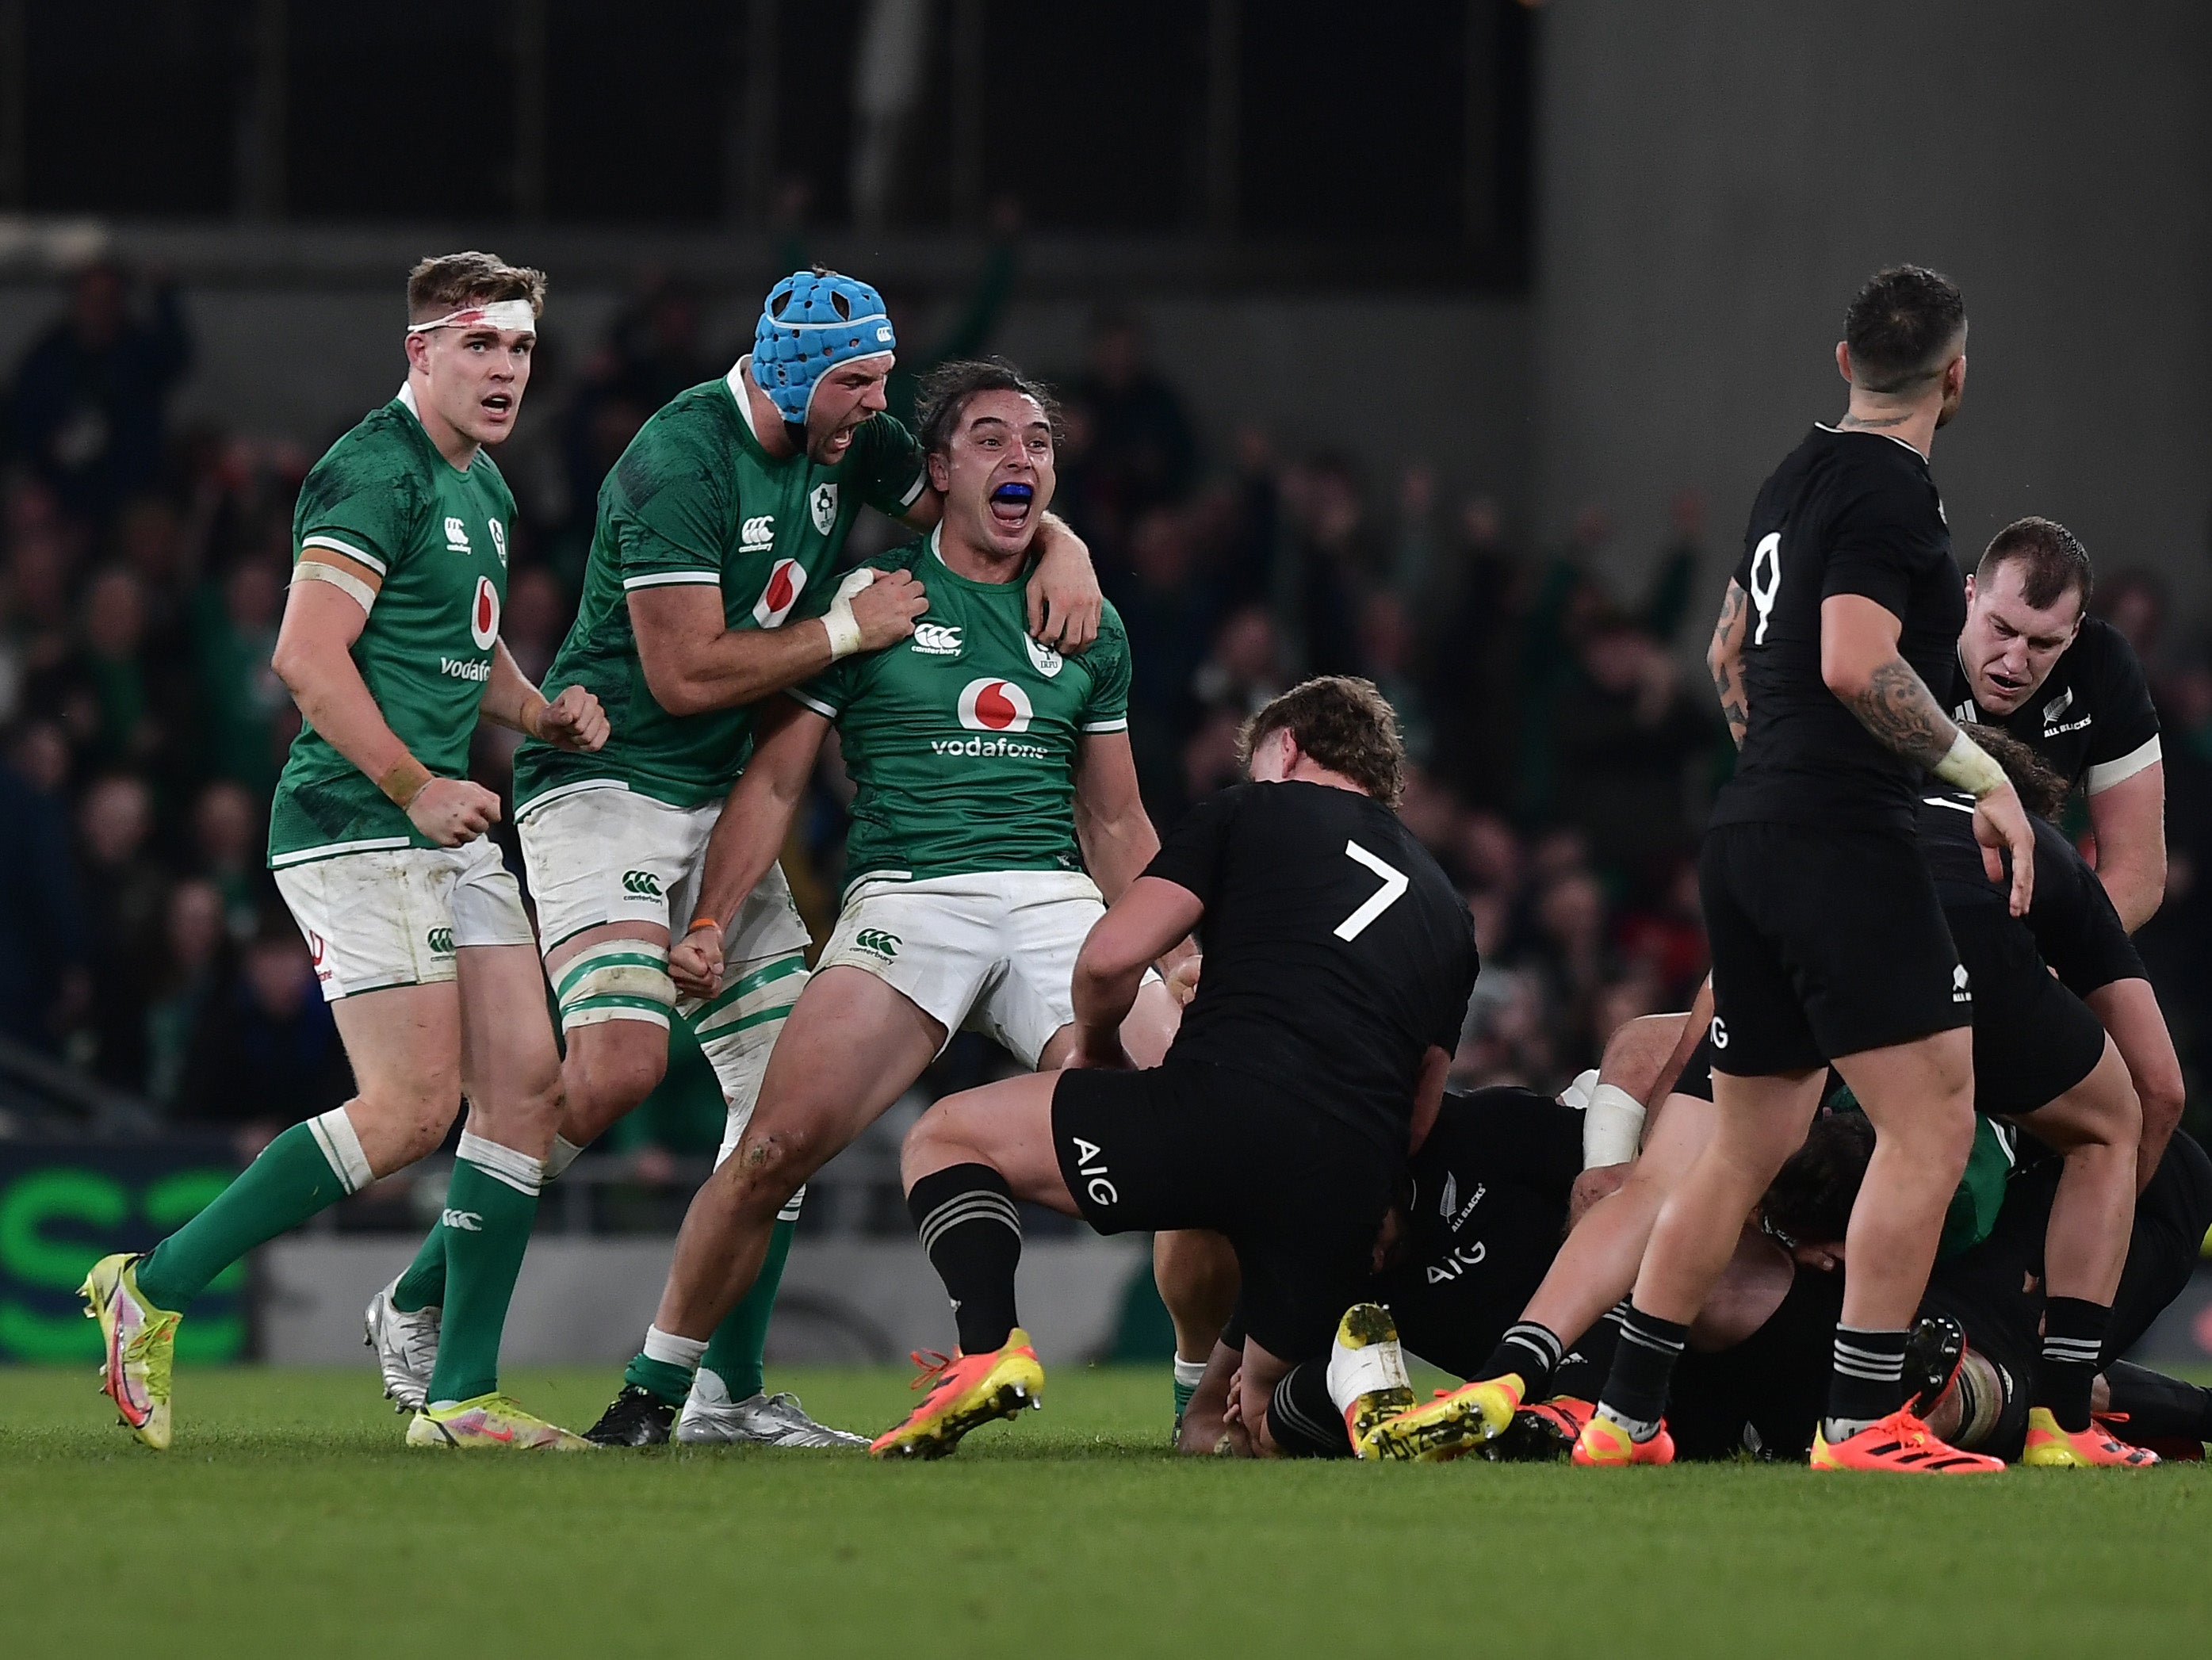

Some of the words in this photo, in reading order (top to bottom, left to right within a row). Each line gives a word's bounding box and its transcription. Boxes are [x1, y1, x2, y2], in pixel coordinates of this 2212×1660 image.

[1750, 531, 1781, 645] 9
[911, 644, 962, 656] canterbury
[1040, 660, 1059, 669] IRFU
[931, 736, 1048, 759] vodafone
[1333, 839, 1410, 943] 7
[1073, 1136, 1119, 1206] AIG
[1451, 1218, 1464, 1233] ALL
[1460, 1188, 1487, 1218] BLACKS
[1427, 1241, 1487, 1284] AIG
